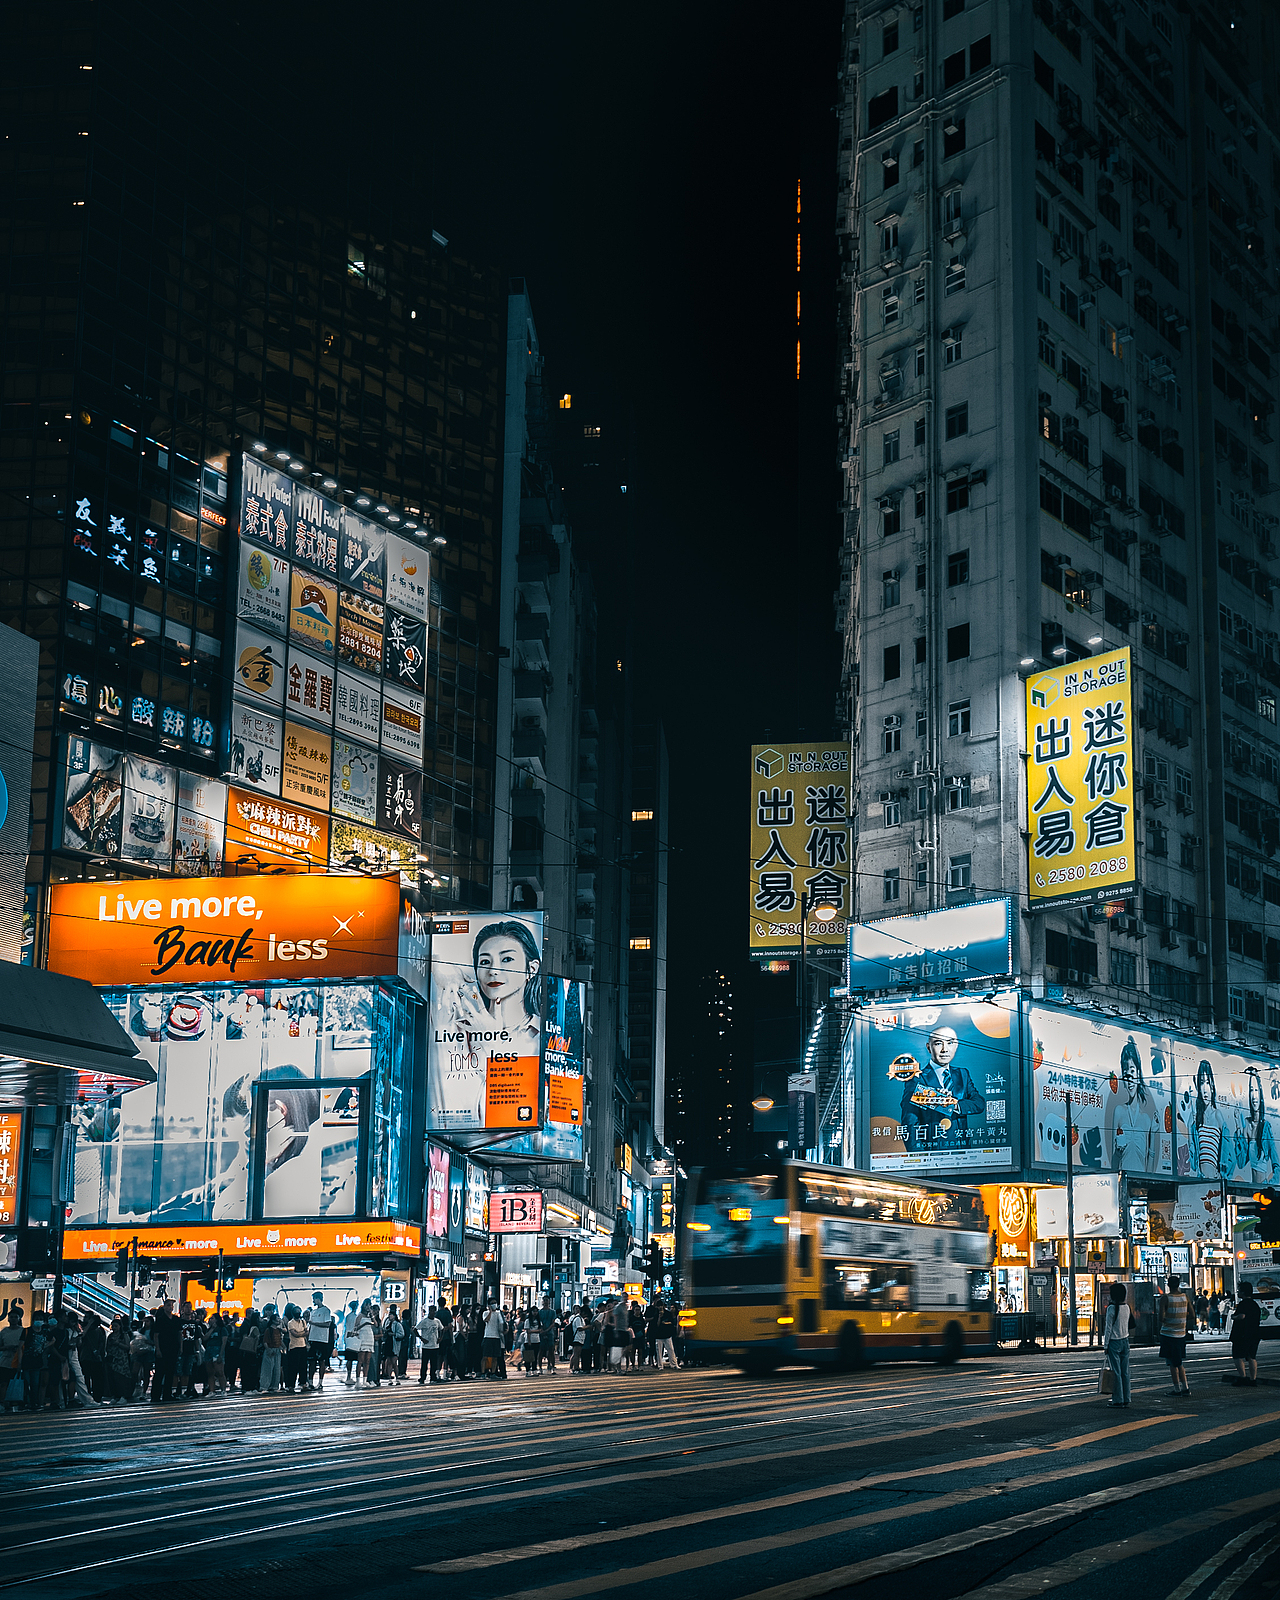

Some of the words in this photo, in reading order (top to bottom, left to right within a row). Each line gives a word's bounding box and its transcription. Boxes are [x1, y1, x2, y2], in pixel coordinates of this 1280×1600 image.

[272, 481, 291, 507] Perfect
[201, 507, 227, 526] PERFECT
[323, 509, 340, 532] Food
[295, 518, 339, 573] 泰式料理
[273, 557, 288, 574] 7/F
[296, 615, 330, 638] 日本料理
[340, 634, 360, 650] 2881
[361, 643, 381, 659] 8204
[1065, 674, 1077, 685] IN
[1083, 669, 1093, 680] N
[1098, 659, 1125, 676] OUT
[1063, 670, 1126, 697] STORAGE
[337, 683, 379, 722] 韓國料理
[409, 699, 422, 711] 6/F
[788, 752, 801, 764] IN
[807, 751, 817, 763] N
[821, 750, 849, 762] OUT
[265, 764, 280, 777] 5/F
[787, 761, 849, 774] STORAGE
[1082, 700, 1130, 852] 迷你倉
[316, 772, 329, 784] 5/F
[1033, 715, 1076, 860] 出入易
[250, 802, 311, 836] 麻辣派對
[411, 822, 420, 833] 5F
[277, 829, 310, 849] PARTY
[754, 786, 798, 914] 出入易
[804, 784, 849, 913] 迷你倉
[1049, 865, 1085, 884] 2580
[1090, 856, 1127, 878] 2088
[98, 893, 162, 922] Live
[169, 893, 265, 921] more,
[809, 921, 846, 935] 2088
[151, 925, 255, 976] Bank
[267, 933, 329, 962] less
[888, 956, 969, 983] 廣告位招租
[435, 1029, 465, 1043] Live
[468, 1029, 513, 1044] more,
[546, 1020, 562, 1035] Live
[450, 1051, 480, 1072] FOMO
[490, 1049, 519, 1064] less
[544, 1051, 568, 1066] more,
[544, 1062, 565, 1078] Bank
[565, 1065, 580, 1080] less
[872, 1126, 892, 1137] 我信
[893, 1124, 949, 1142] 馬百良
[500, 1198, 528, 1223] iB
[1175, 1212, 1201, 1221] famille
[83, 1240, 108, 1253] Live
[112, 1238, 124, 1251] for
[185, 1239, 219, 1250] more
[236, 1236, 262, 1249] Live
[284, 1236, 318, 1247] more
[335, 1233, 362, 1246] Live
[1173, 1252, 1188, 1263] SUN
[384, 1282, 406, 1300] iB
[195, 1299, 216, 1309] Live
